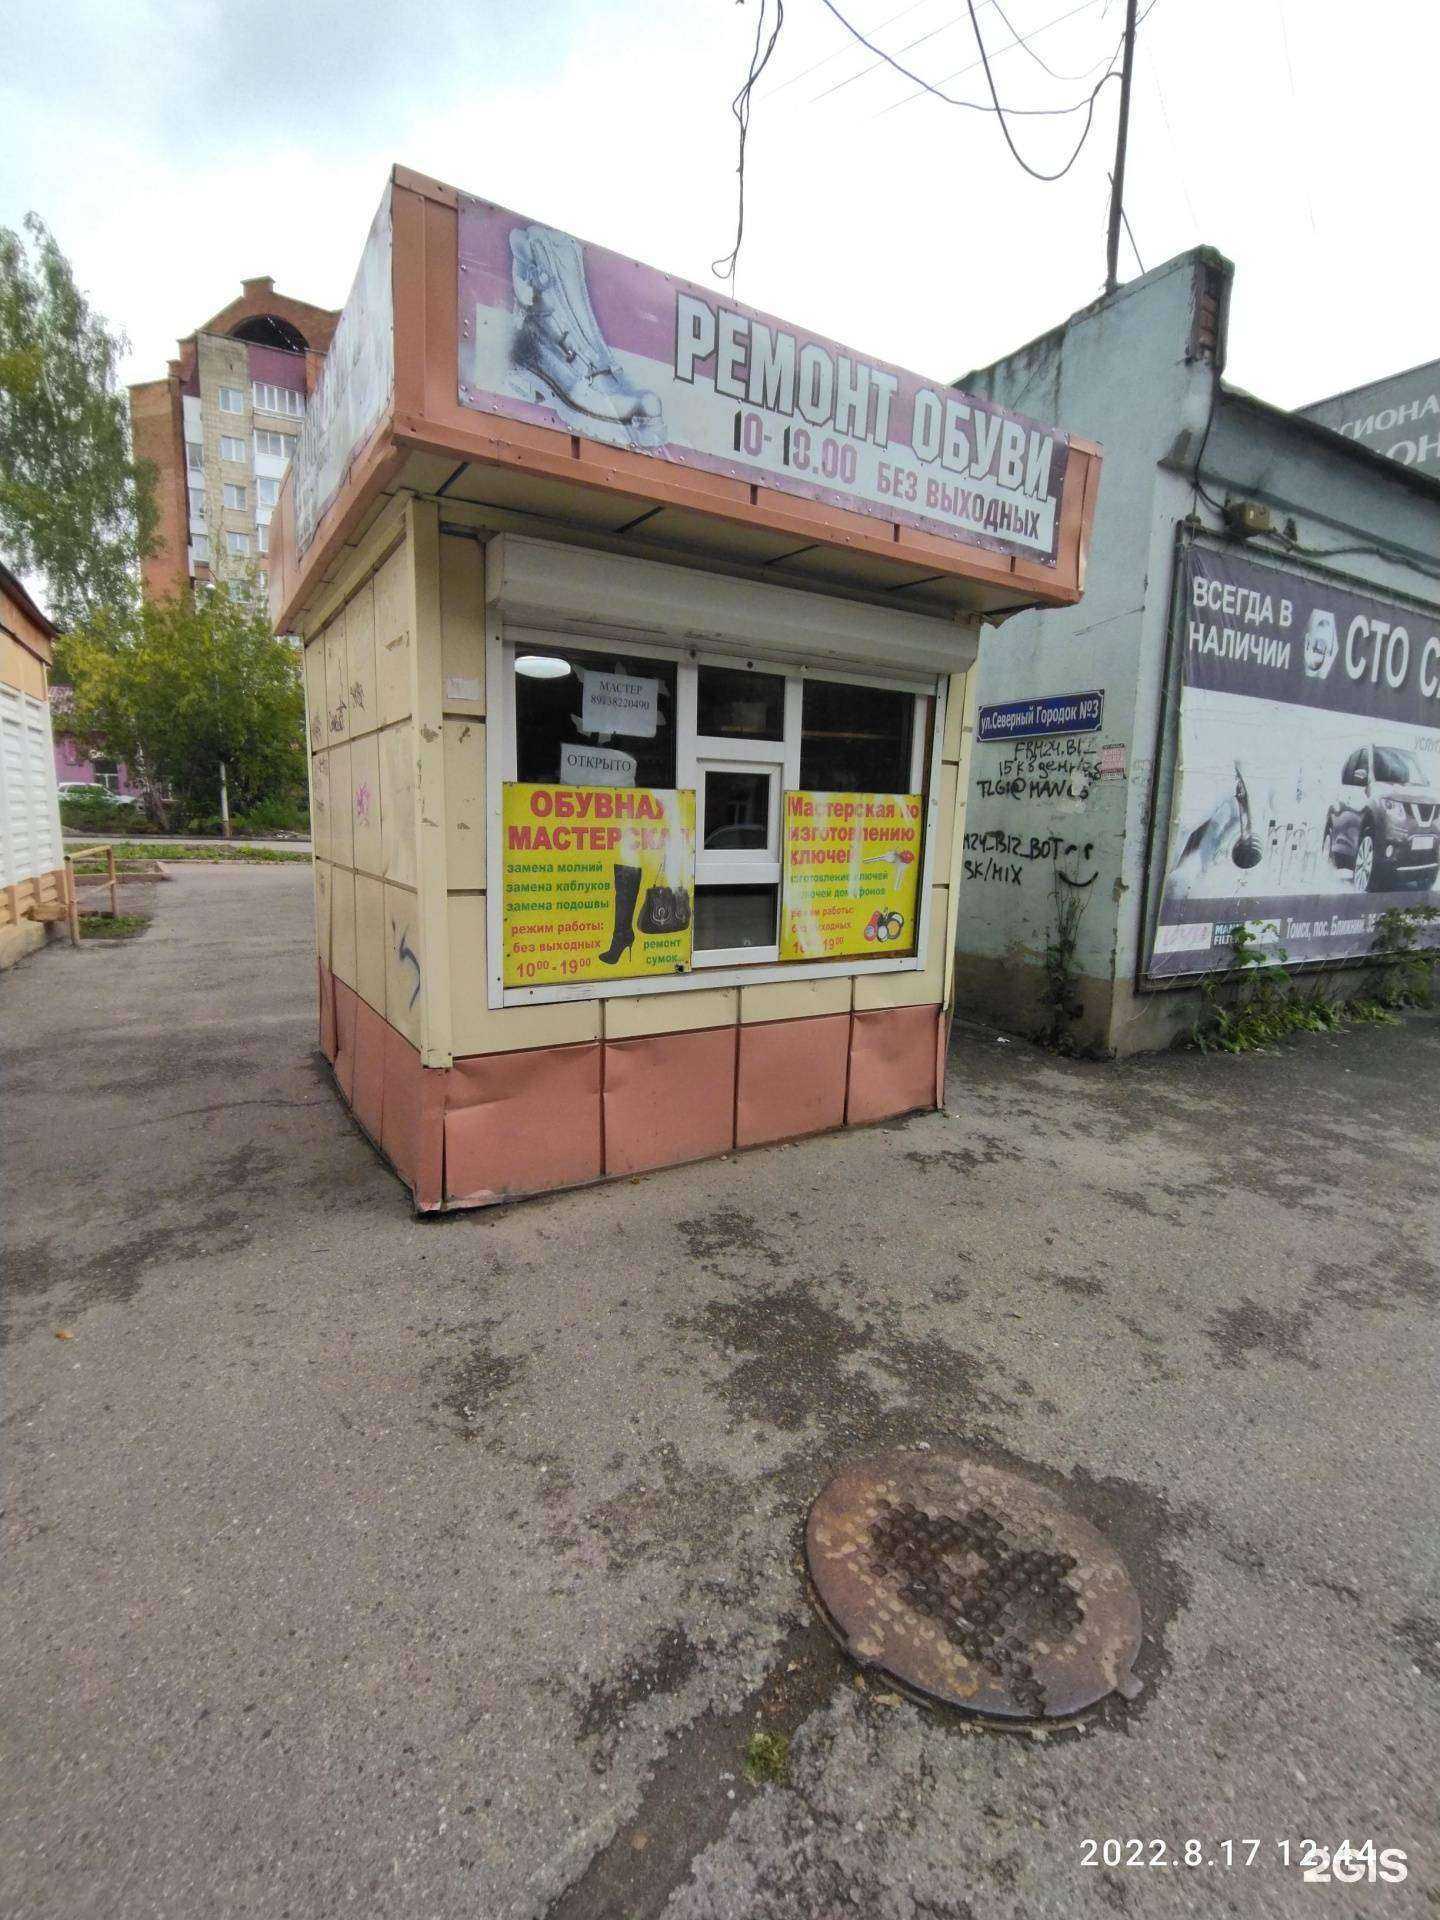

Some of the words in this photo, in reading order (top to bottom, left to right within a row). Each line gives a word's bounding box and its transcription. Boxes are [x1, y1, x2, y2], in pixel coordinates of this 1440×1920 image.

[674, 291, 897, 448] РЕМОНТ
[910, 387, 1055, 502] ОБУВИ
[877, 461, 919, 503] БЕЗ
[926, 477, 1041, 541] ВЫХОДНЫХ
[1193, 575, 1274, 626] ВСЕГДА
[1279, 598, 1293, 627] В
[1189, 620, 1291, 670] НАЛИЧИИ
[1345, 614, 1410, 689] СТО
[1420, 636, 1440, 698] С
[599, 680, 643, 695] МАСТЕР
[981, 707, 1034, 734] ул.Северный
[1036, 705, 1079, 727] Городок
[567, 754, 631, 772] ОТКРЫТО
[790, 848, 852, 866] ключе
[507, 863, 554, 874] замена
[557, 861, 603, 873] молний
[506, 882, 552, 892] замена
[556, 881, 611, 893] каблуков
[507, 901, 552, 912] замена
[556, 899, 609, 911] подошвы
[511, 924, 554, 937] режим
[557, 920, 604, 936] работы:
[512, 942, 536, 954] без
[539, 940, 601, 953] выходных
[643, 938, 681, 951] ремонт
